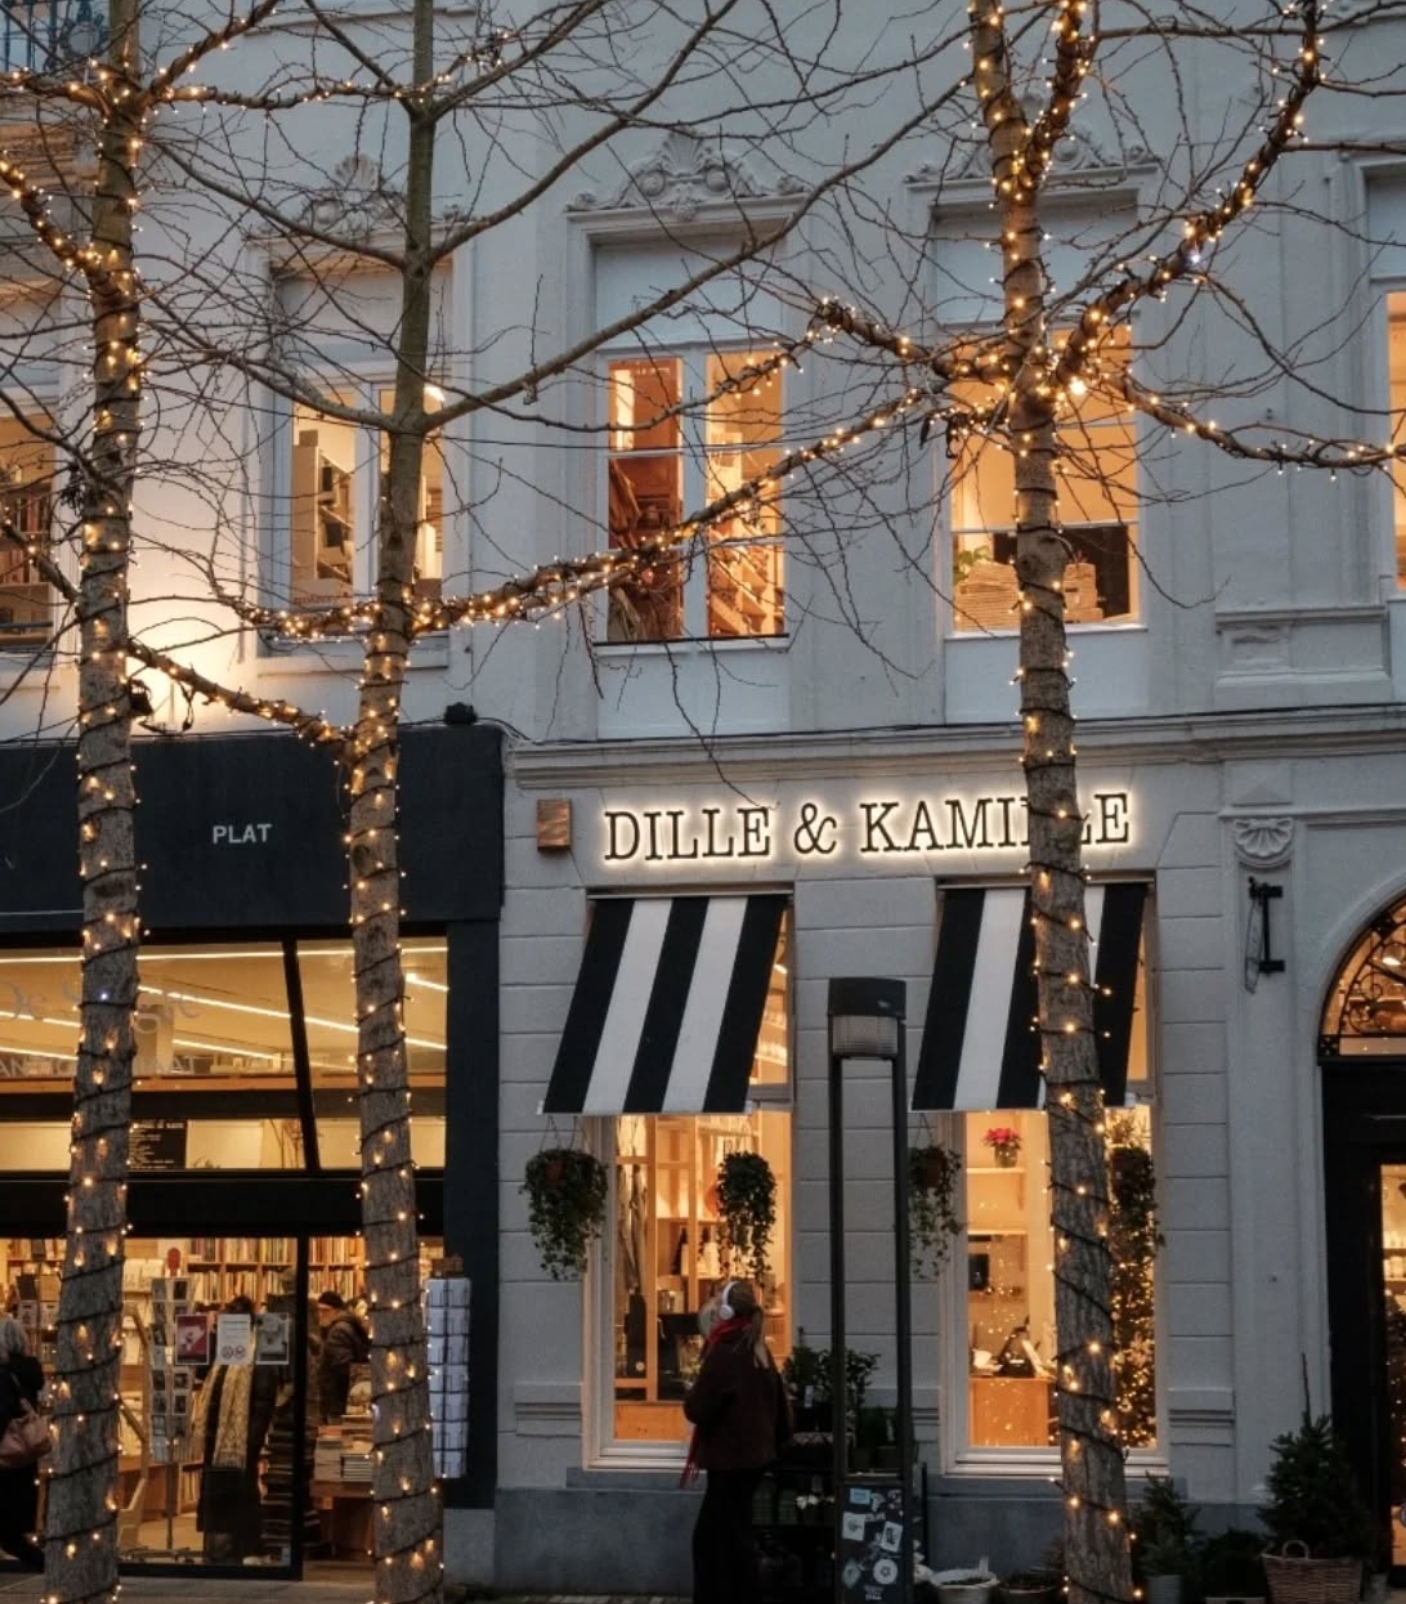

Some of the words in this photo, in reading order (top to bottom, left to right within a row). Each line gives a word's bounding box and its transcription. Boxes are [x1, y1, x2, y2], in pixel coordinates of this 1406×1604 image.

[213, 823, 272, 844] PLAT
[604, 808, 770, 860] DILLE
[794, 802, 837, 854] &
[859, 792, 1129, 853] KAMIE
